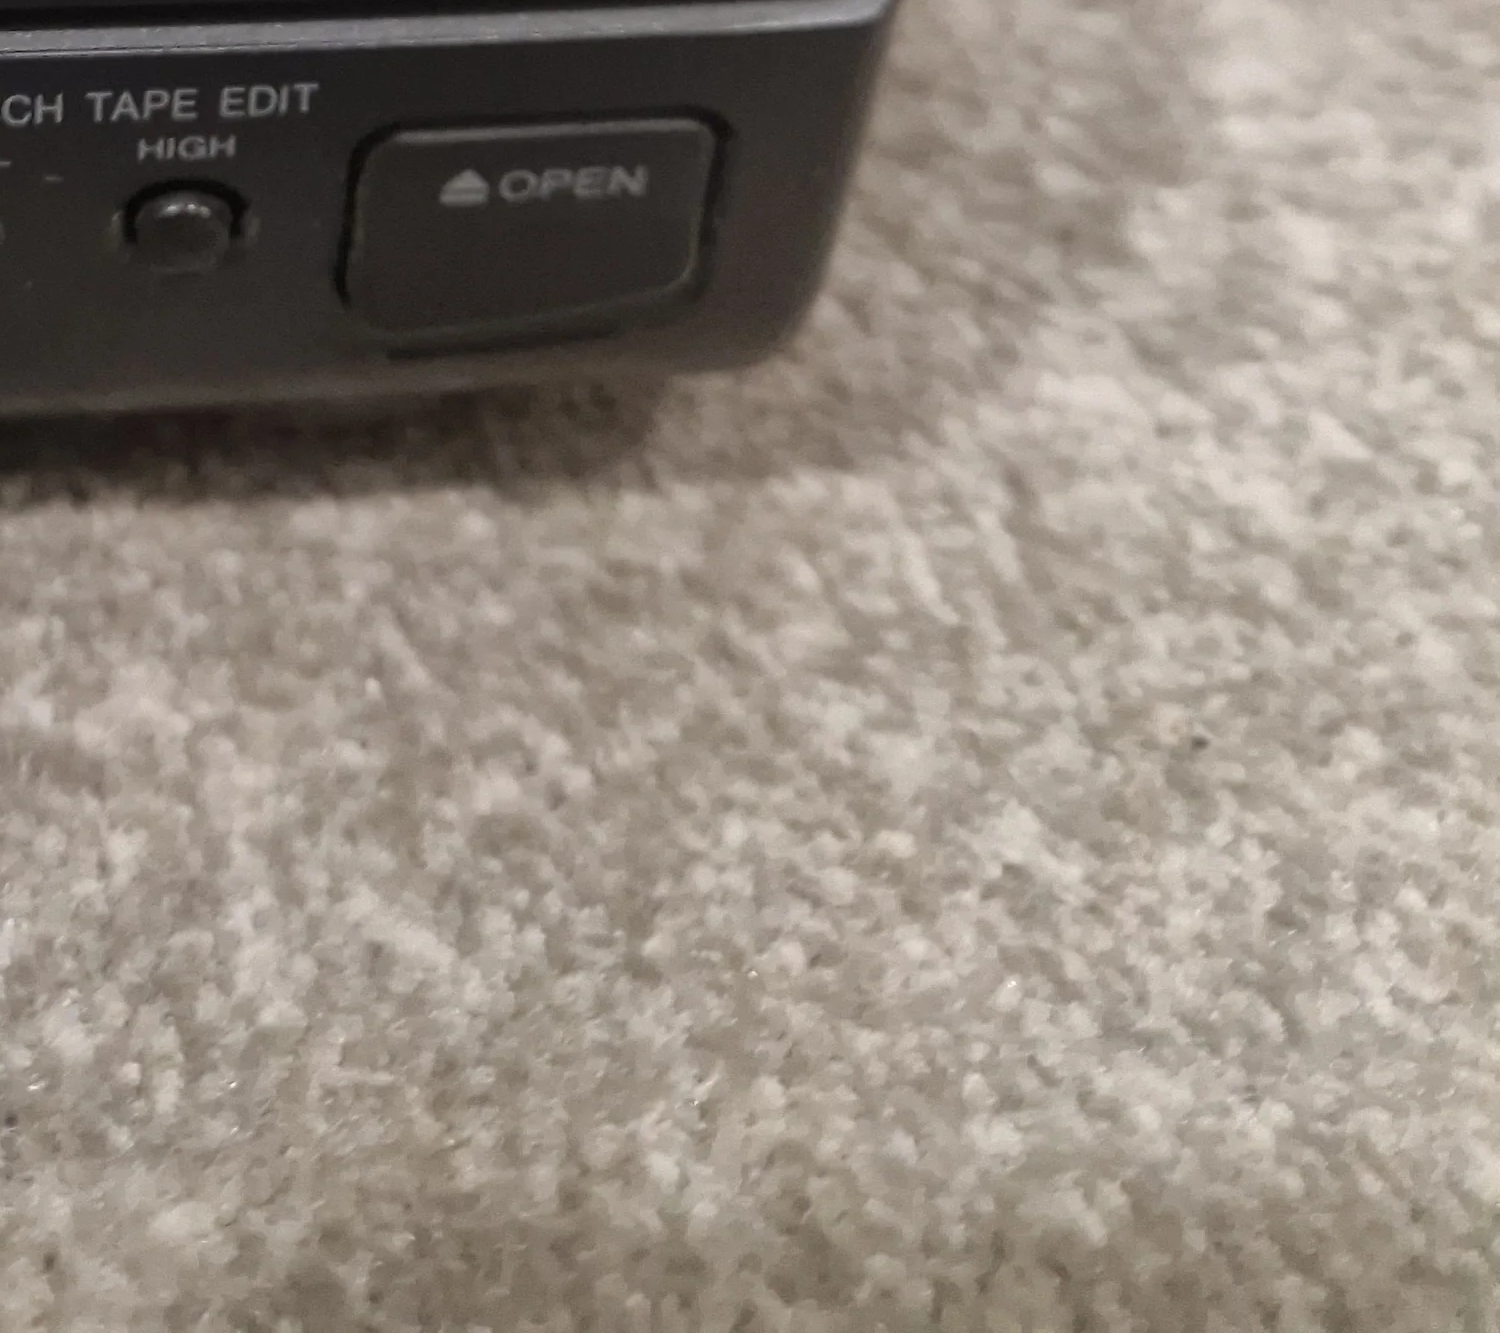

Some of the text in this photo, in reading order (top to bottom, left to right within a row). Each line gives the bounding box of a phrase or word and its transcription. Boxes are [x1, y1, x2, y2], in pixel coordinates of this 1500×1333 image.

[85, 88, 198, 123] TAPE
[218, 82, 320, 119] EDIT
[136, 134, 236, 162] HIGH
[499, 164, 650, 202] OPEN
